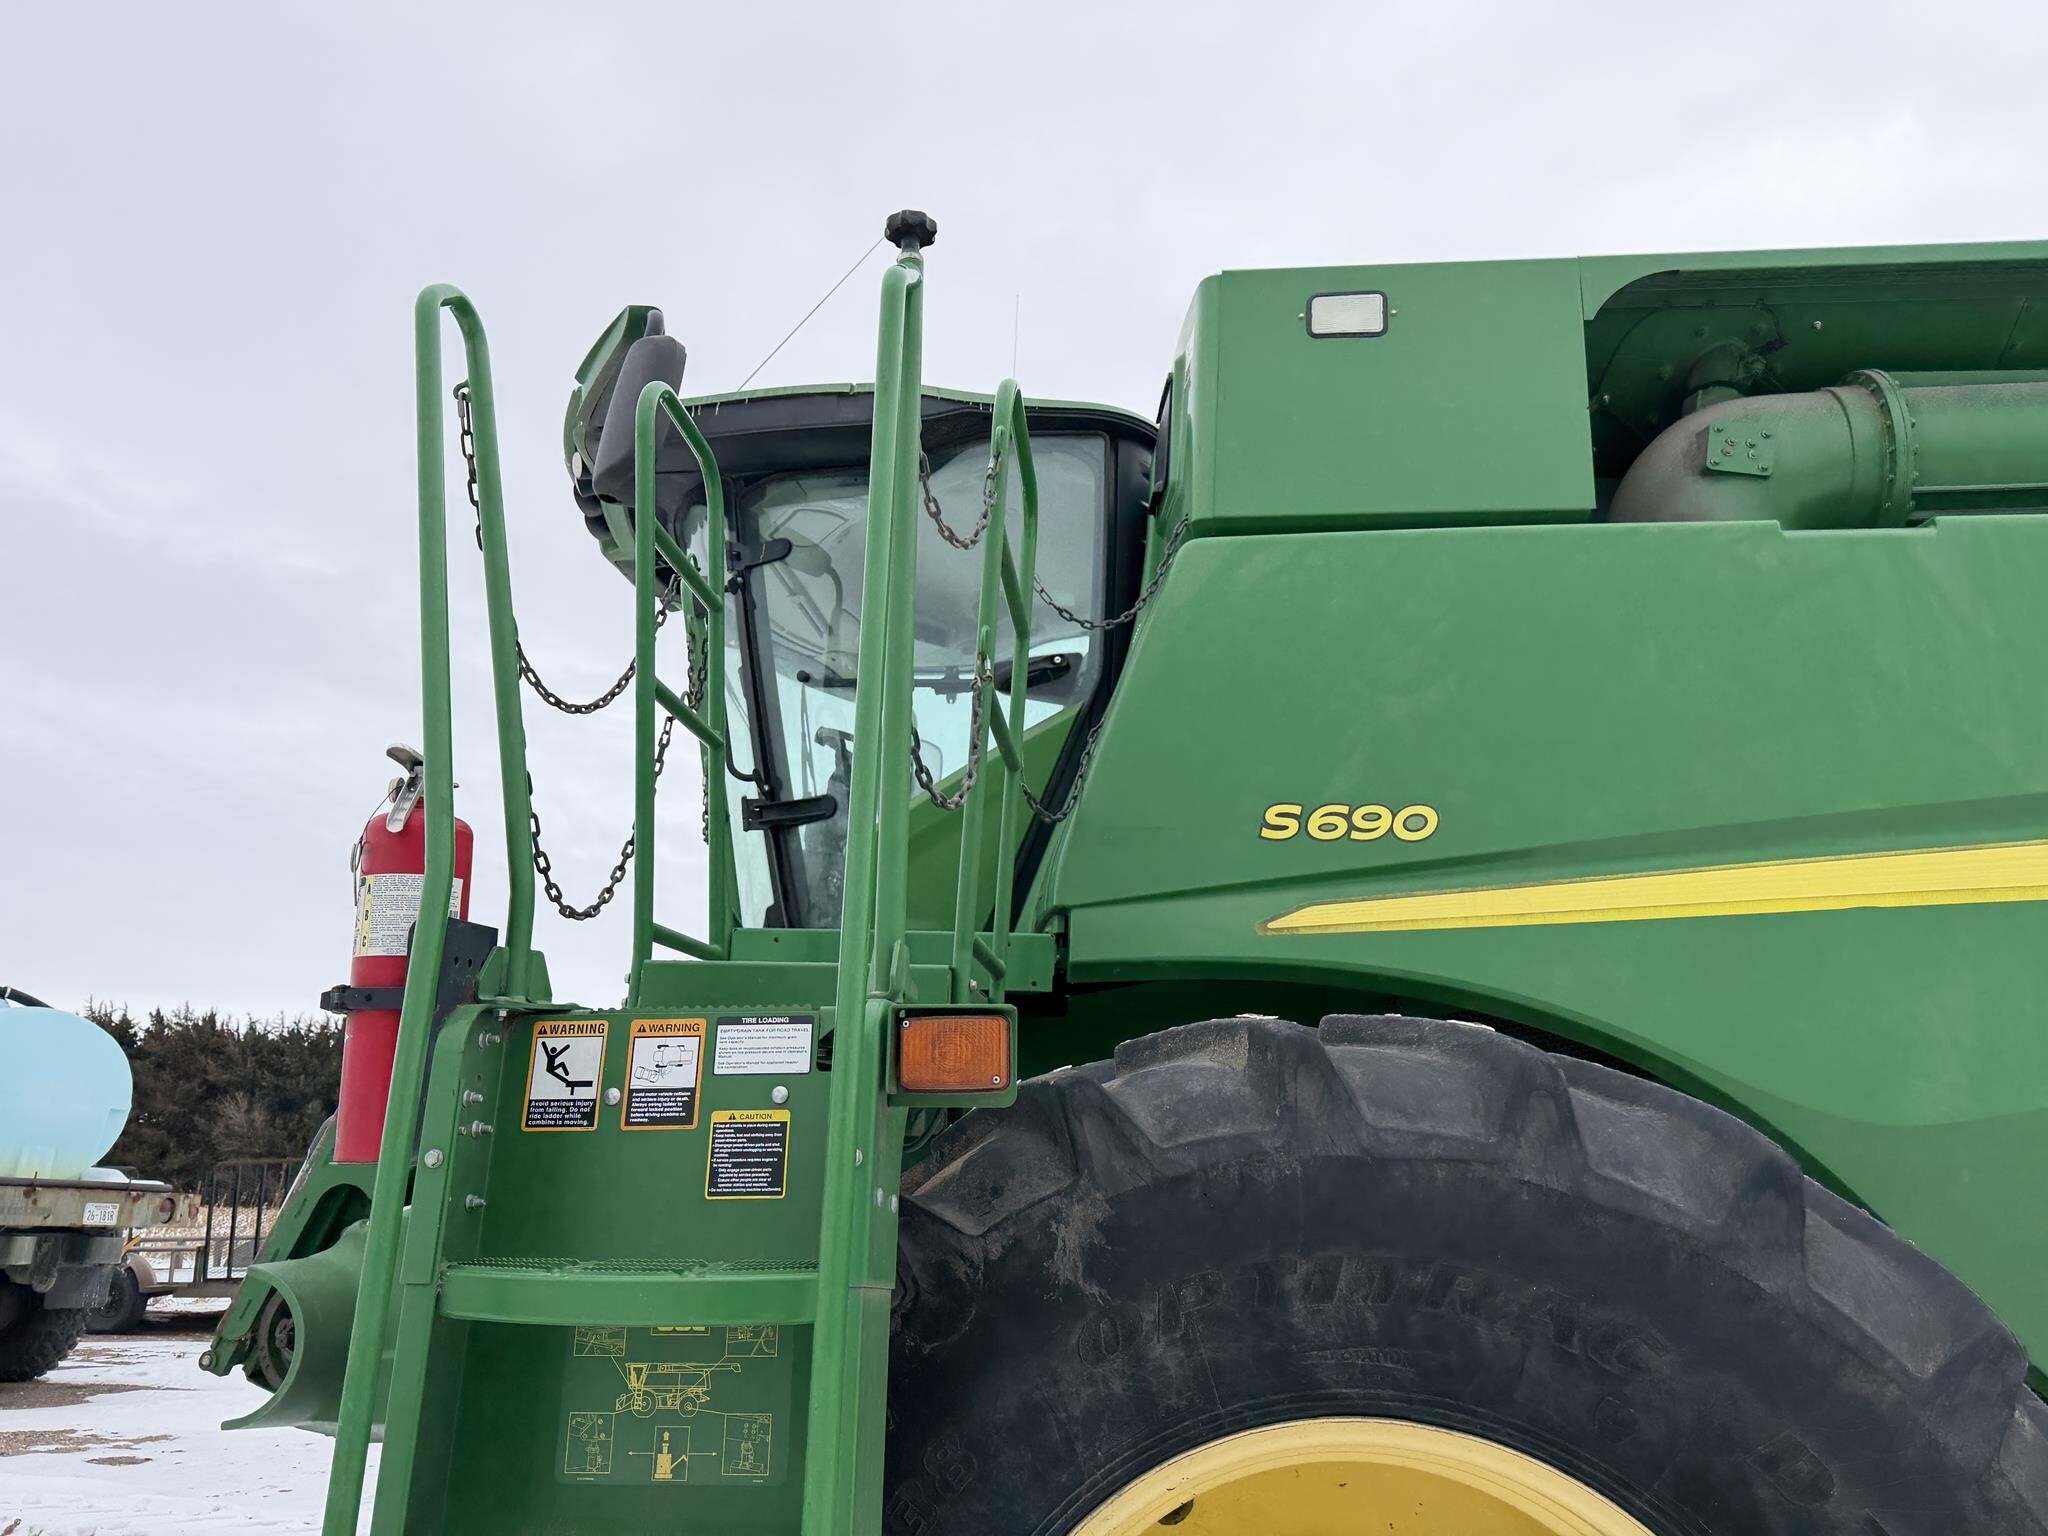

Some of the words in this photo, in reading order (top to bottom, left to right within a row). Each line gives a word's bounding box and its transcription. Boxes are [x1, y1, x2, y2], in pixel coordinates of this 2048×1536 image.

[1260, 803, 1440, 841] S690
[550, 1024, 605, 1034] WARNING
[649, 1024, 700, 1033] WARNING
[576, 1100, 593, 1108] injury
